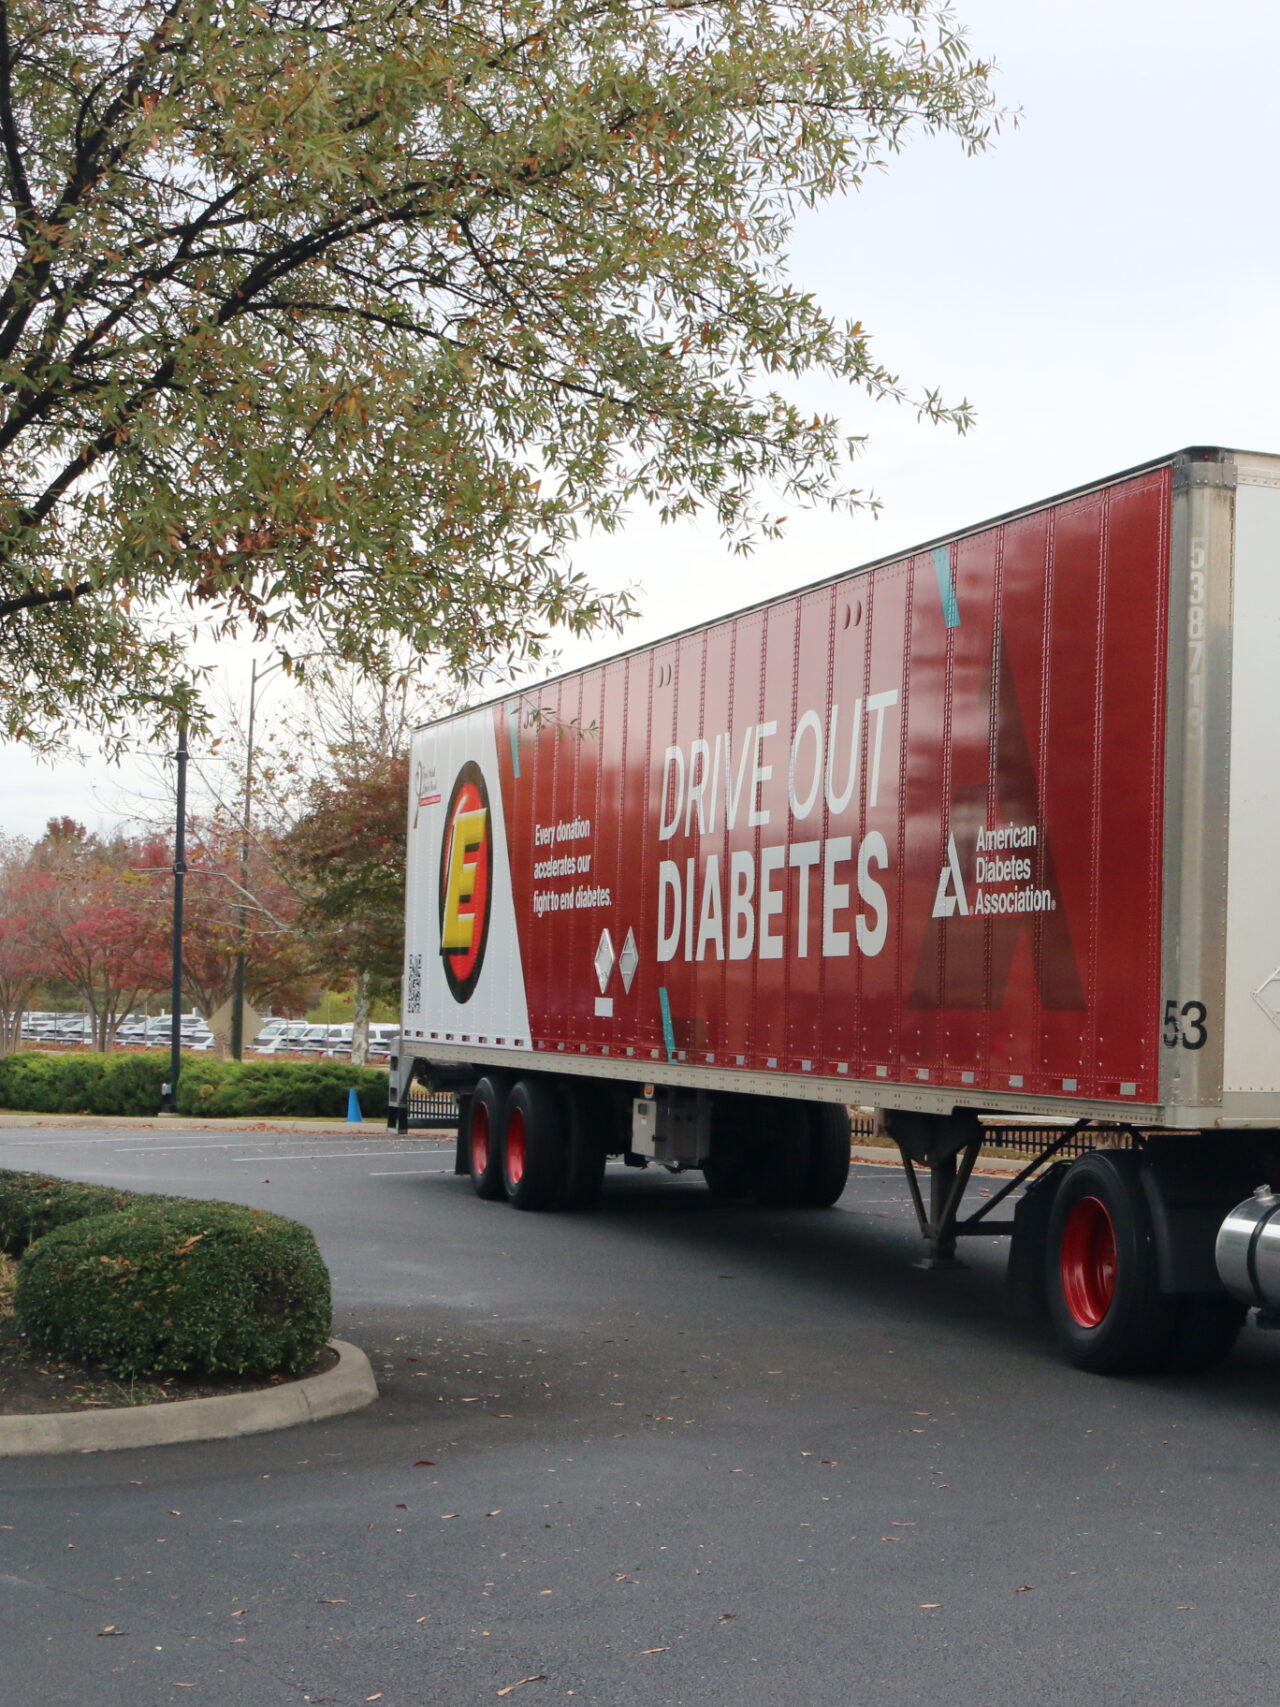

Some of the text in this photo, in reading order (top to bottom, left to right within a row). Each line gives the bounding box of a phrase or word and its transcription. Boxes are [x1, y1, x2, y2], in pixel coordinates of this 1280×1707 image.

[659, 689, 898, 840] DRIVE OUT
[535, 815, 590, 848] Every donation
[976, 821, 1037, 852] American
[440, 808, 487, 955] E
[534, 854, 591, 879] accelerates our
[976, 855, 1031, 883] Diabetes
[533, 885, 612, 918] fight to end diabetes.
[657, 831, 889, 962] DIABETES
[1163, 1000, 1208, 1050] 53
